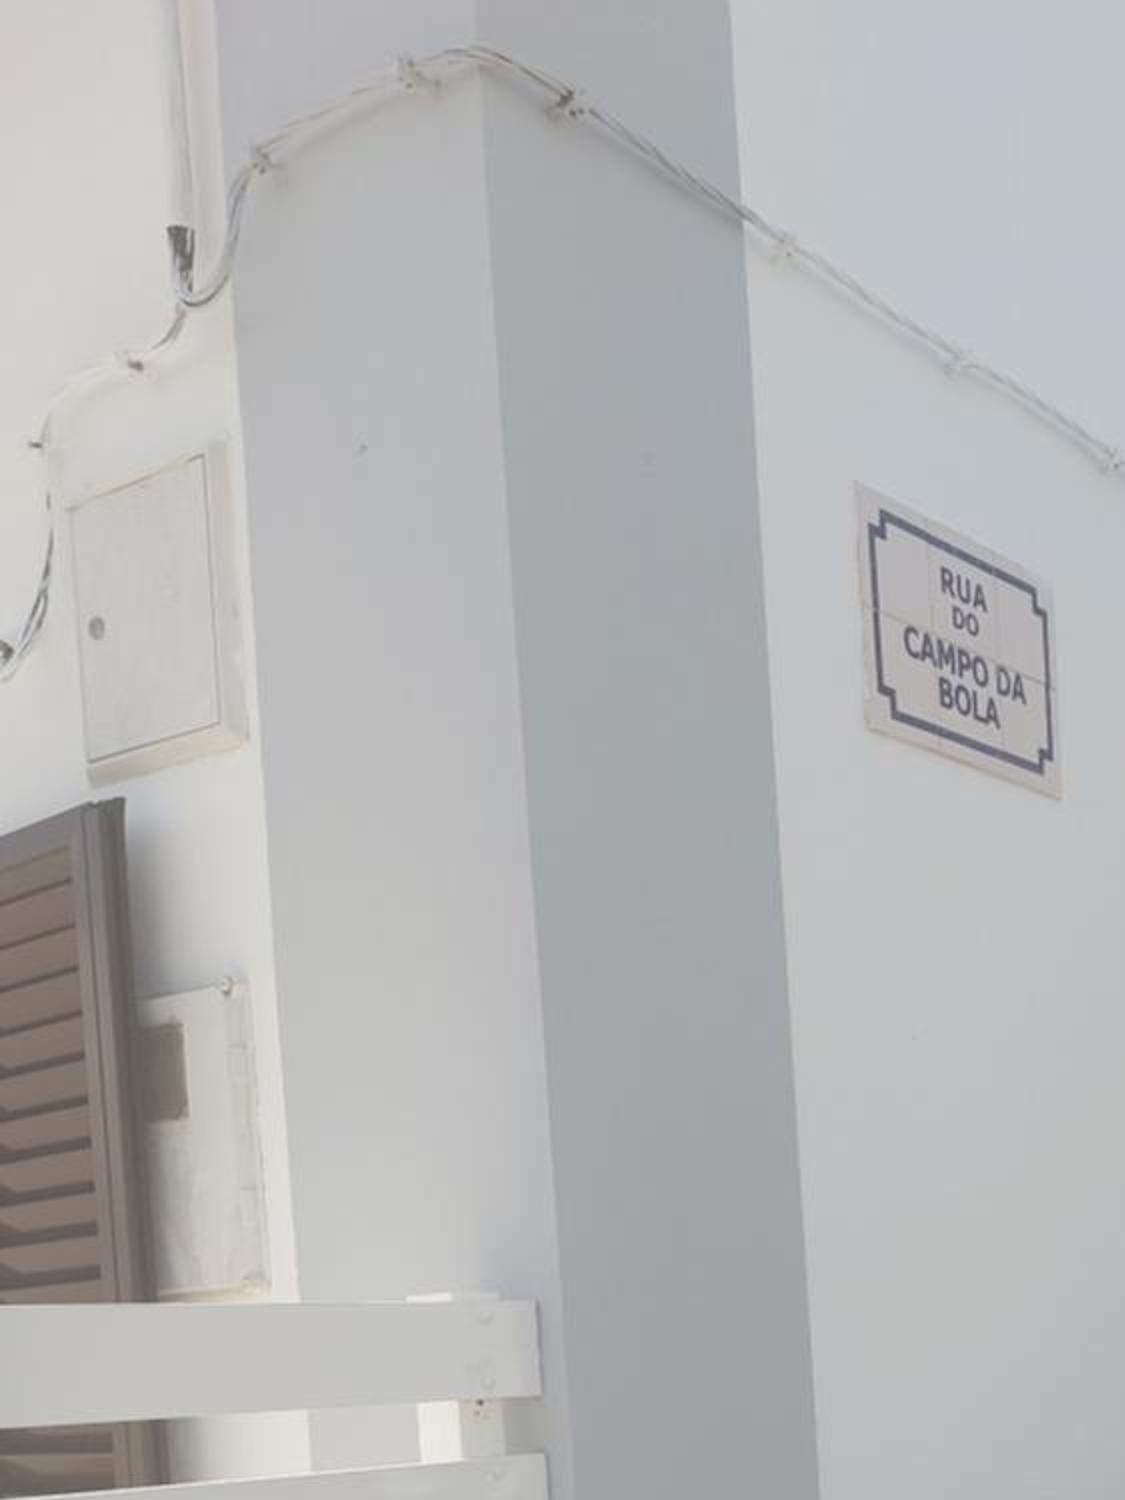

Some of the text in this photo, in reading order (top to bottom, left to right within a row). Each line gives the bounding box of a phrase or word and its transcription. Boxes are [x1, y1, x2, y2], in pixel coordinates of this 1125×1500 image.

[940, 566, 988, 612] RUA
[952, 607, 980, 636] DO
[903, 626, 1027, 704] CAMPO DA
[938, 677, 1001, 728] BOLA
